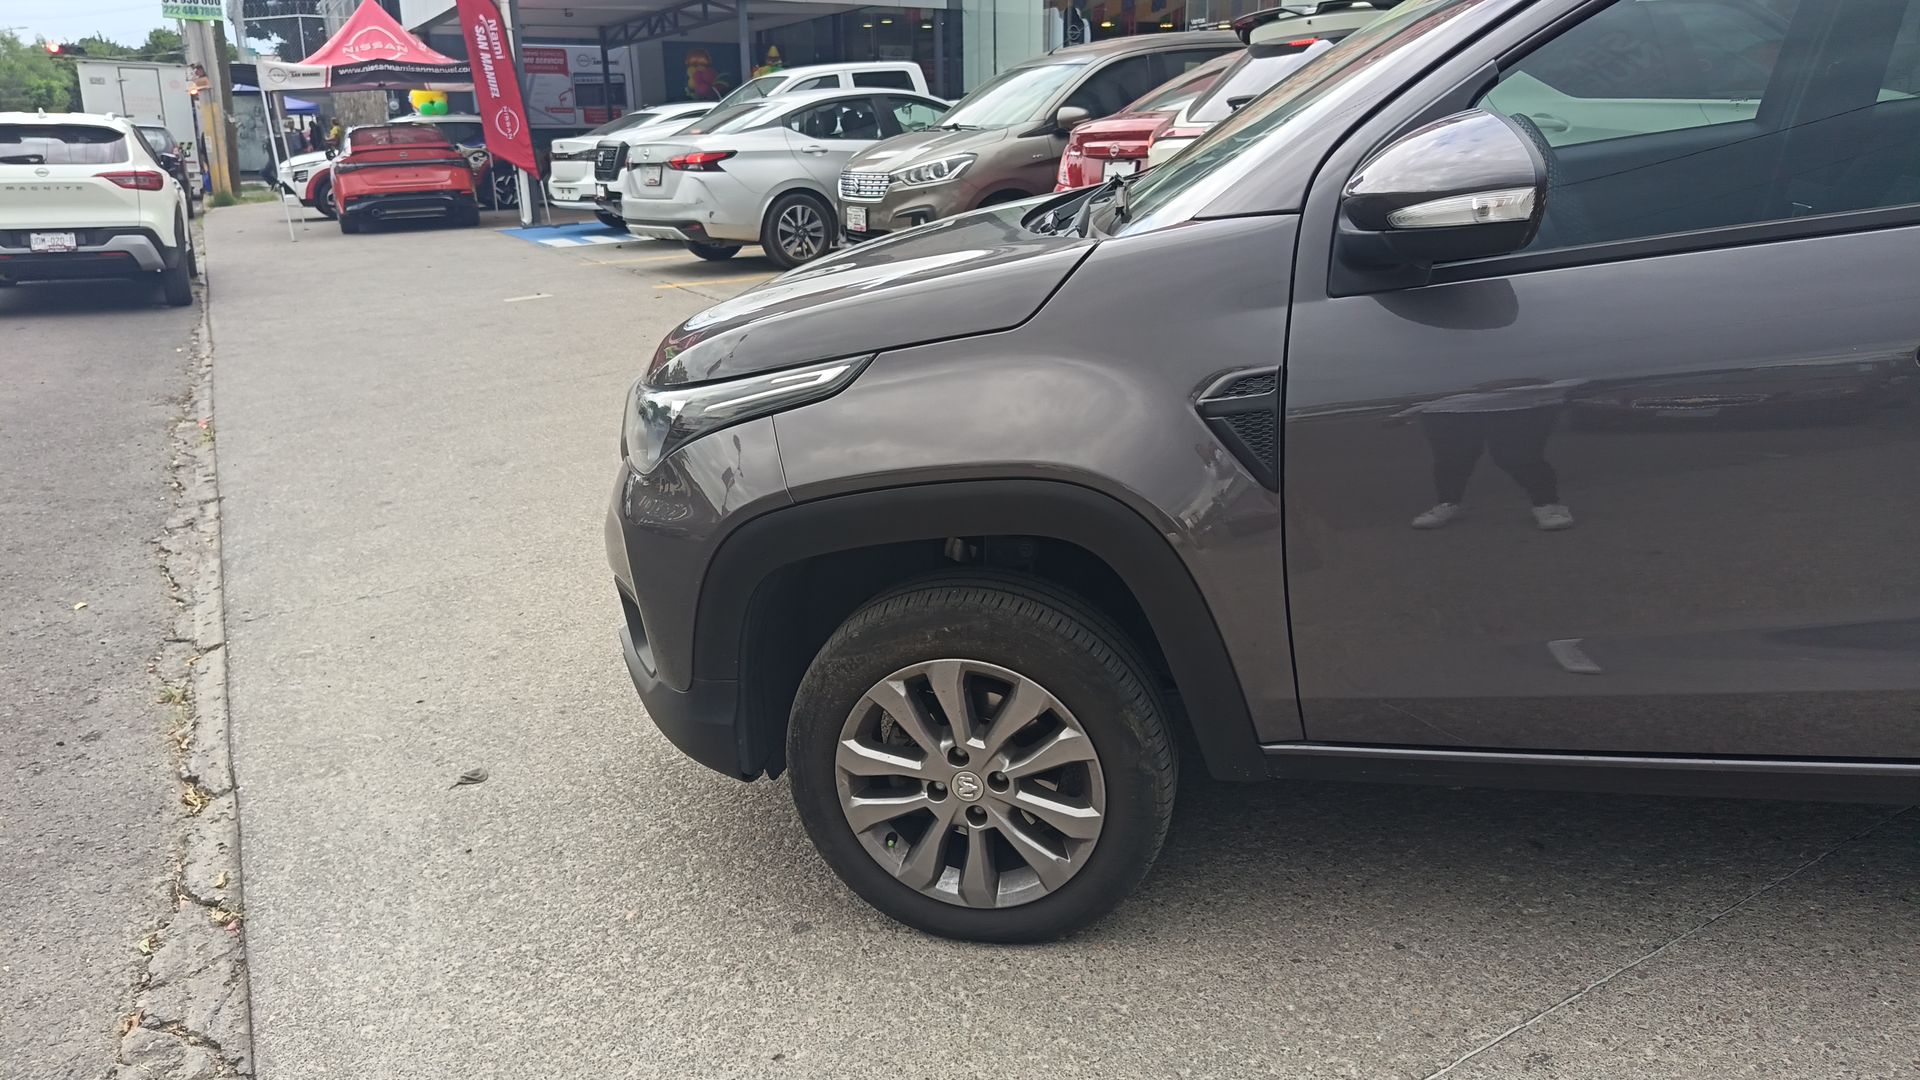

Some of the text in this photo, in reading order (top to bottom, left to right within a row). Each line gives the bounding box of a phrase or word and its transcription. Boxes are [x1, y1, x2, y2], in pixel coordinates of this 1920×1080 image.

[342, 41, 409, 54] NISSAN
[487, 19, 505, 60] Nami
[475, 25, 500, 98] SAN MANUEL
[502, 106, 513, 140] NISSAN
